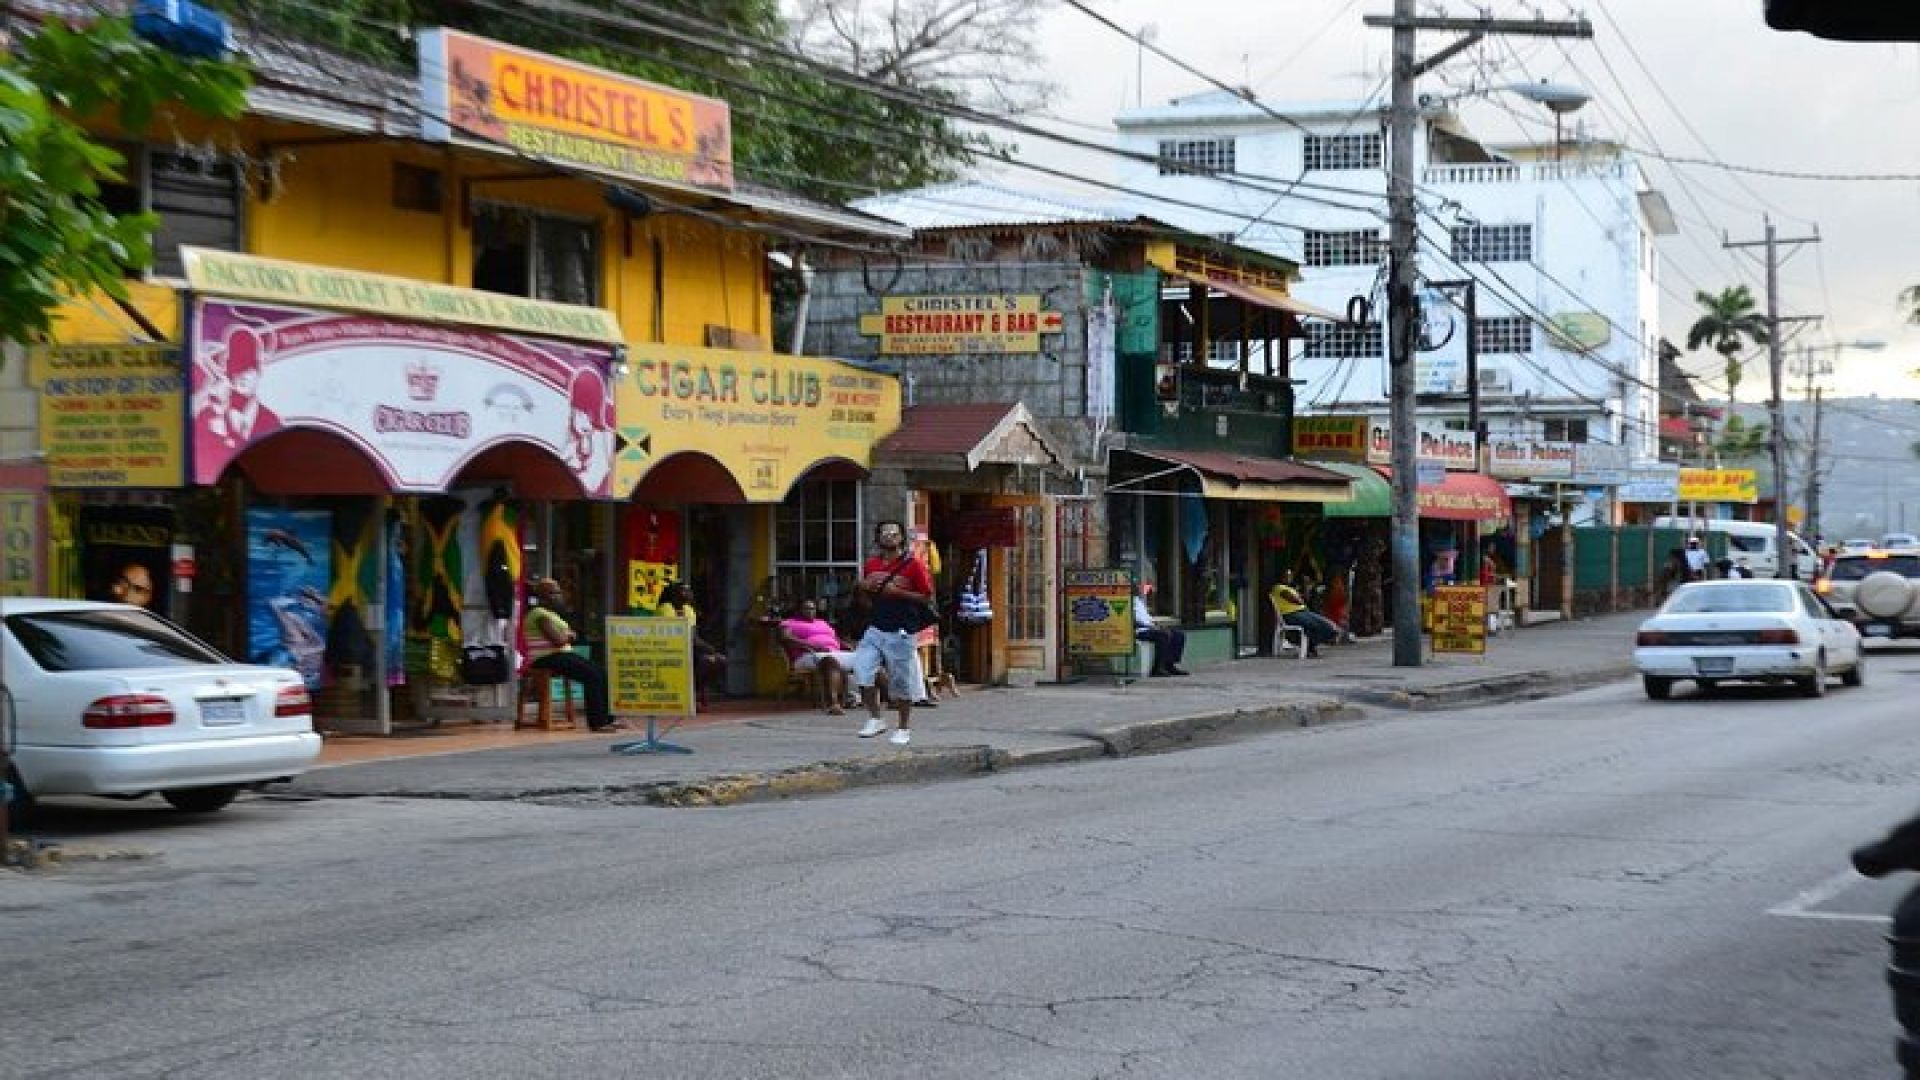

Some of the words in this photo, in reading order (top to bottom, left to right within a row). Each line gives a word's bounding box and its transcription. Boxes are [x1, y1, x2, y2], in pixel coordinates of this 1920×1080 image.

[508, 122, 625, 171] RESTAURANT
[885, 314, 983, 334] RESTAURANT
[1007, 314, 1038, 333] BAR
[50, 349, 118, 370] CIGAR
[635, 359, 739, 405] CIGAR
[750, 365, 822, 408] CLUB
